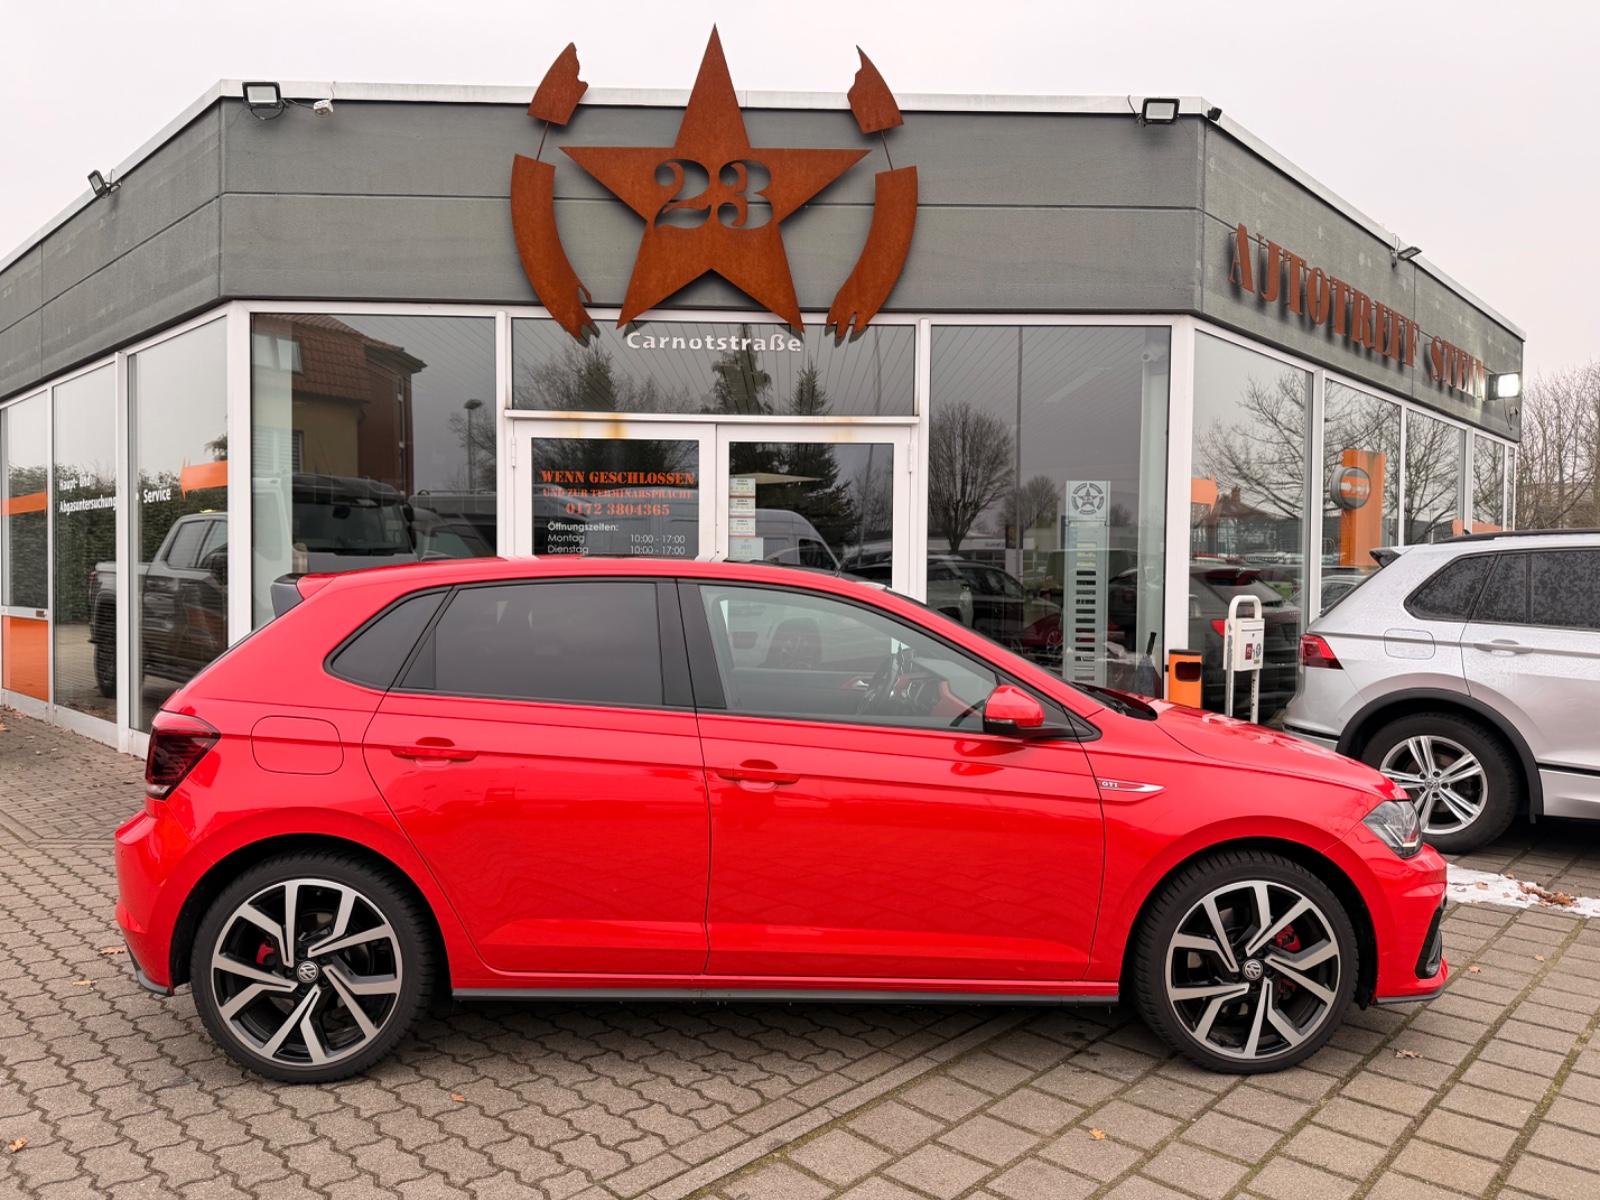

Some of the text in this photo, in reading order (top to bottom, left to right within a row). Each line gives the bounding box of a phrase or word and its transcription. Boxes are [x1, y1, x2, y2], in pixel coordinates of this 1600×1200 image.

[654, 159, 774, 230] 23
[1229, 223, 1420, 368] AUTOTREFF
[626, 332, 801, 352] Carnotstraße
[541, 470, 696, 485] WENN GESCHLOSSEN
[143, 488, 171, 503] Service
[59, 494, 117, 515] Abgasuntersuchung
[565, 503, 670, 516] 0172 3804365
[547, 522, 619, 532] Öffnungszeiten:
[547, 534, 585, 544] Montag
[630, 535, 653, 543] 10:00
[662, 535, 686, 544] 17:00
[547, 545, 588, 554] Dienstag
[630, 546, 653, 554] 10:00
[662, 546, 686, 555] 17:00
